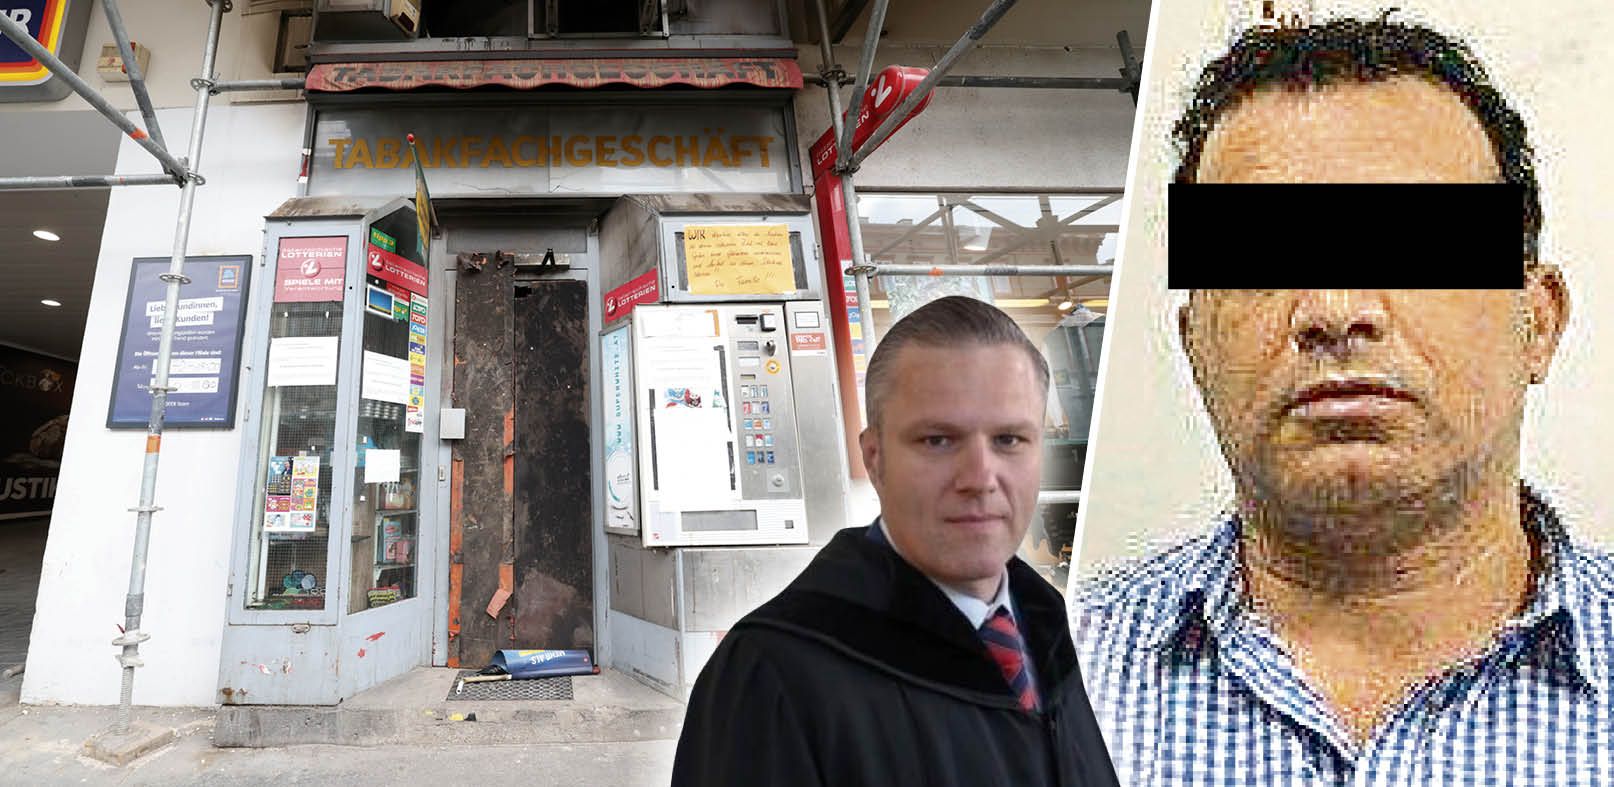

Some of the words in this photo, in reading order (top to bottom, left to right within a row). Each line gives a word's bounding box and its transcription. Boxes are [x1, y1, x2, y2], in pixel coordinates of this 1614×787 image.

[328, 127, 775, 169] TABAKFACHGESCHÄFT
[688, 229, 706, 240] WIR
[281, 250, 343, 258] LOTTERIEN
[385, 264, 426, 287] LOTTERIEN
[284, 278, 320, 286] SPIELE
[324, 278, 343, 286] MIT
[617, 284, 656, 307] LOTTERIEN
[150, 303, 166, 312] Lieb
